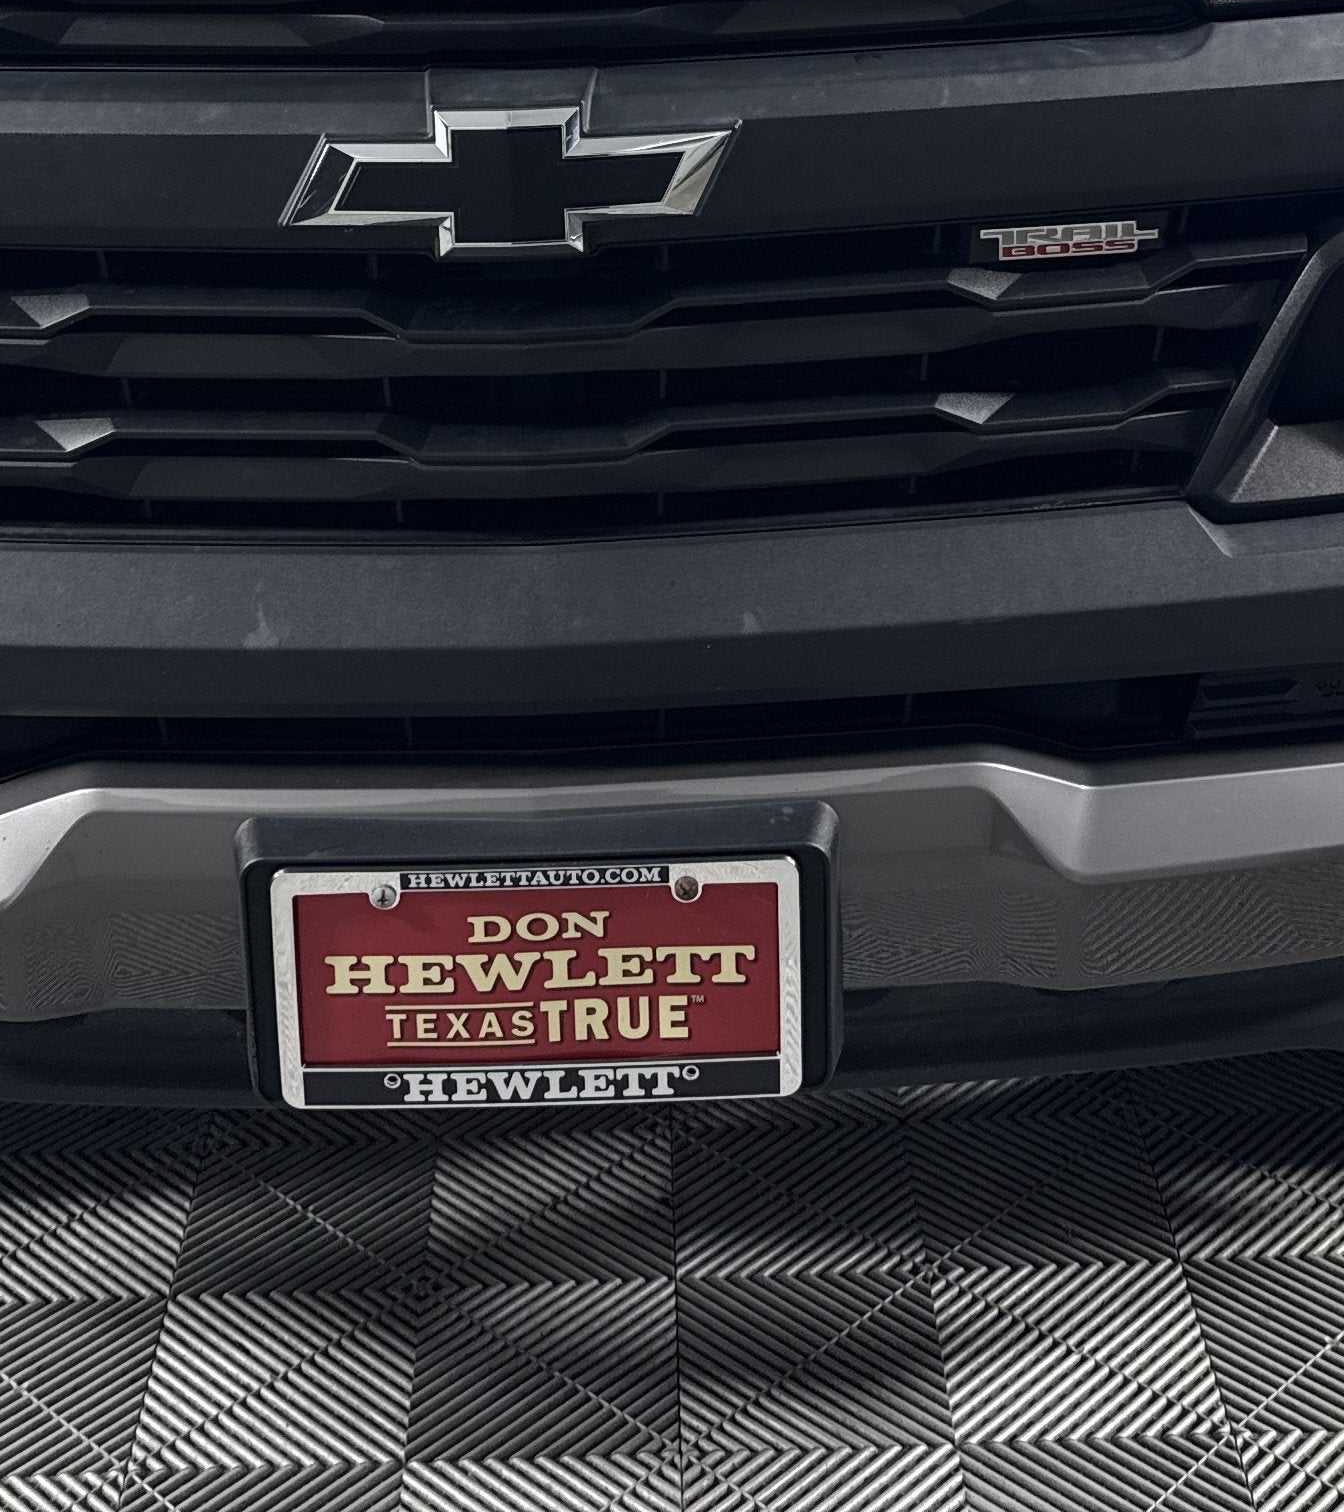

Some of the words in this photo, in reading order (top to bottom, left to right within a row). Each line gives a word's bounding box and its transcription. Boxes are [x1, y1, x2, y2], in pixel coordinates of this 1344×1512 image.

[980, 221, 1158, 245] TRAIL
[1000, 238, 1137, 260] BOSS
[407, 866, 661, 888] HEWLETTAUTO.COM
[466, 910, 611, 944] DON
[324, 944, 756, 995] HEWLETT
[403, 1066, 681, 1104] HEWLETT
